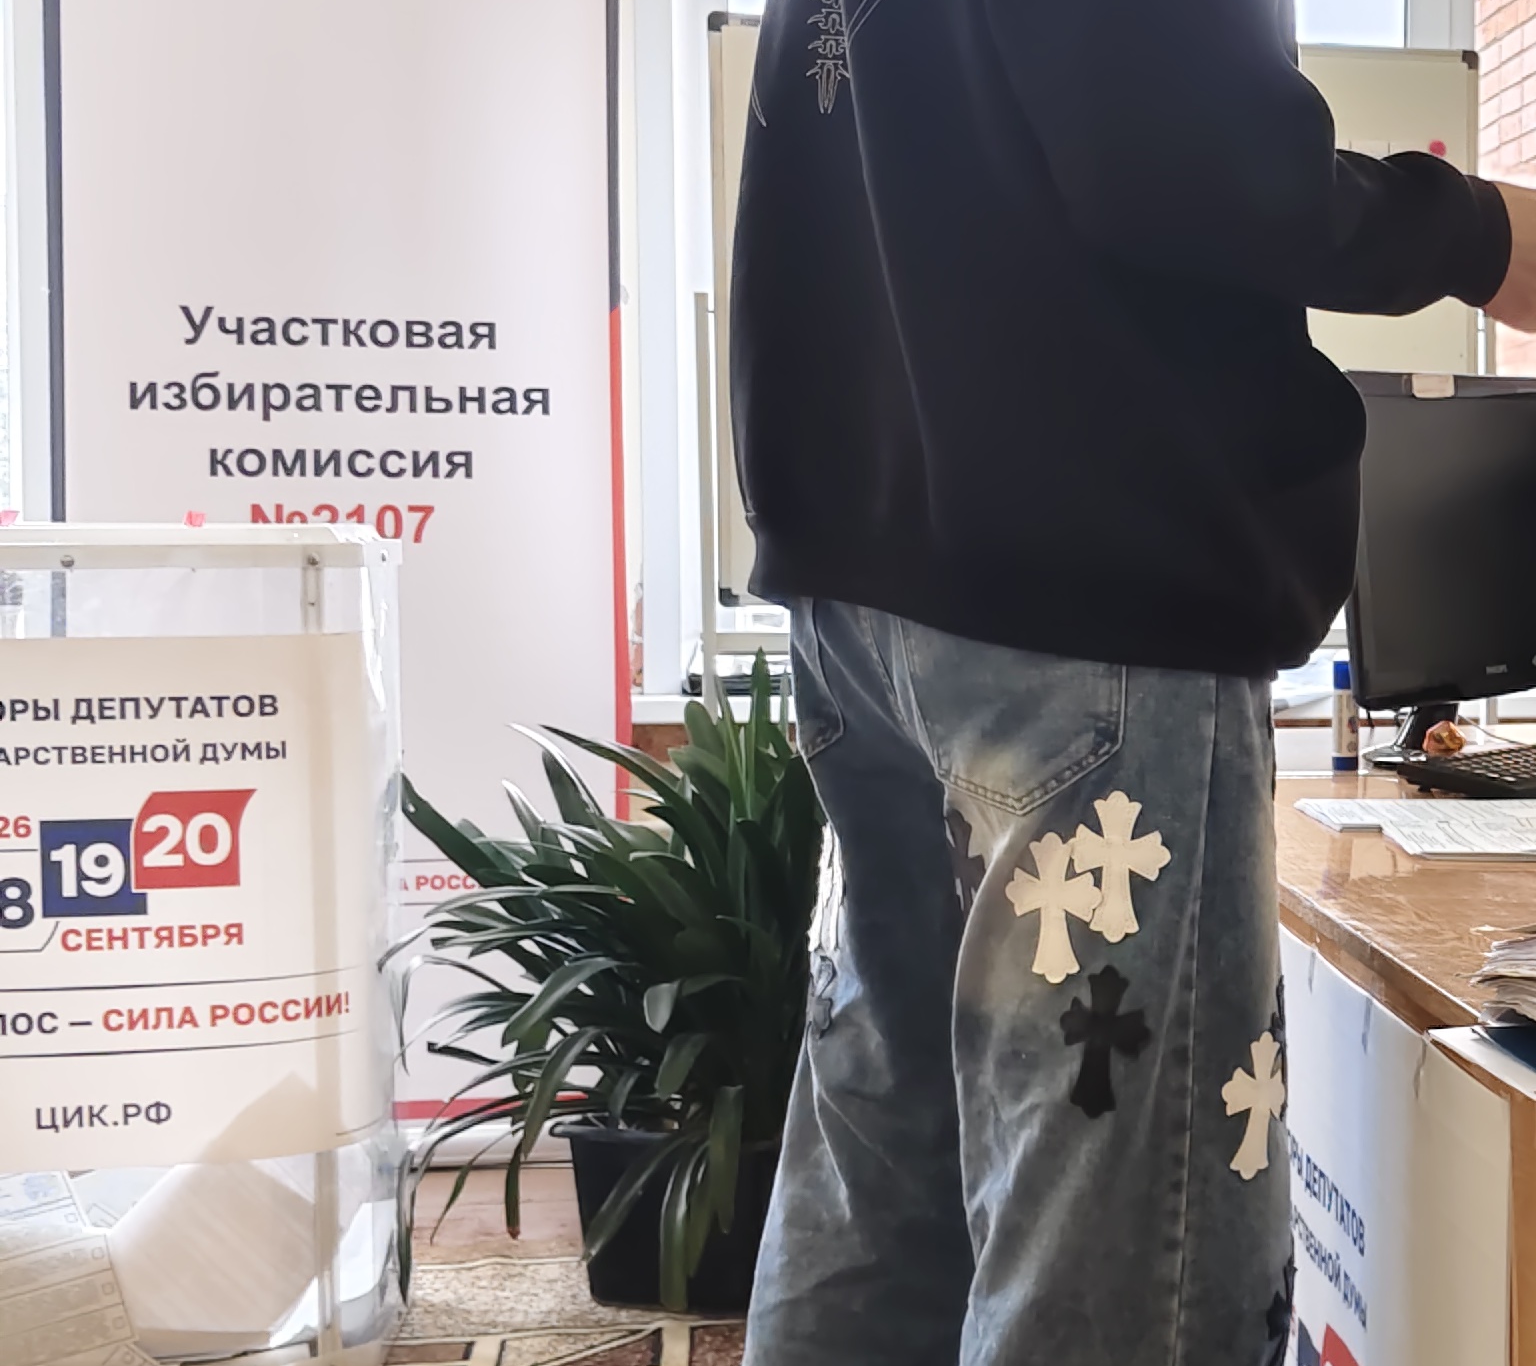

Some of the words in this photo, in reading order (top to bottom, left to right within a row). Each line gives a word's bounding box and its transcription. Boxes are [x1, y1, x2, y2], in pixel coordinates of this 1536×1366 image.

[180, 305, 497, 350] Участковая
[129, 371, 550, 421] избирательная
[210, 446, 473, 481] комиссия
[71, 694, 279, 724] ДЕПУТАТОВ
[199, 740, 288, 763] ДУМЫ
[50, 842, 125, 898] 19
[142, 812, 232, 868] 20
[415, 874, 478, 891] РОСС
[60, 922, 244, 952] СЕНТЯБРЯ
[102, 1005, 198, 1033] СИЛА
[210, 991, 350, 1029] РОССИИ!
[35, 1100, 173, 1133] ЦИК.РФ
[1304, 1151, 1367, 1257] ДЕПУТАТОВ
